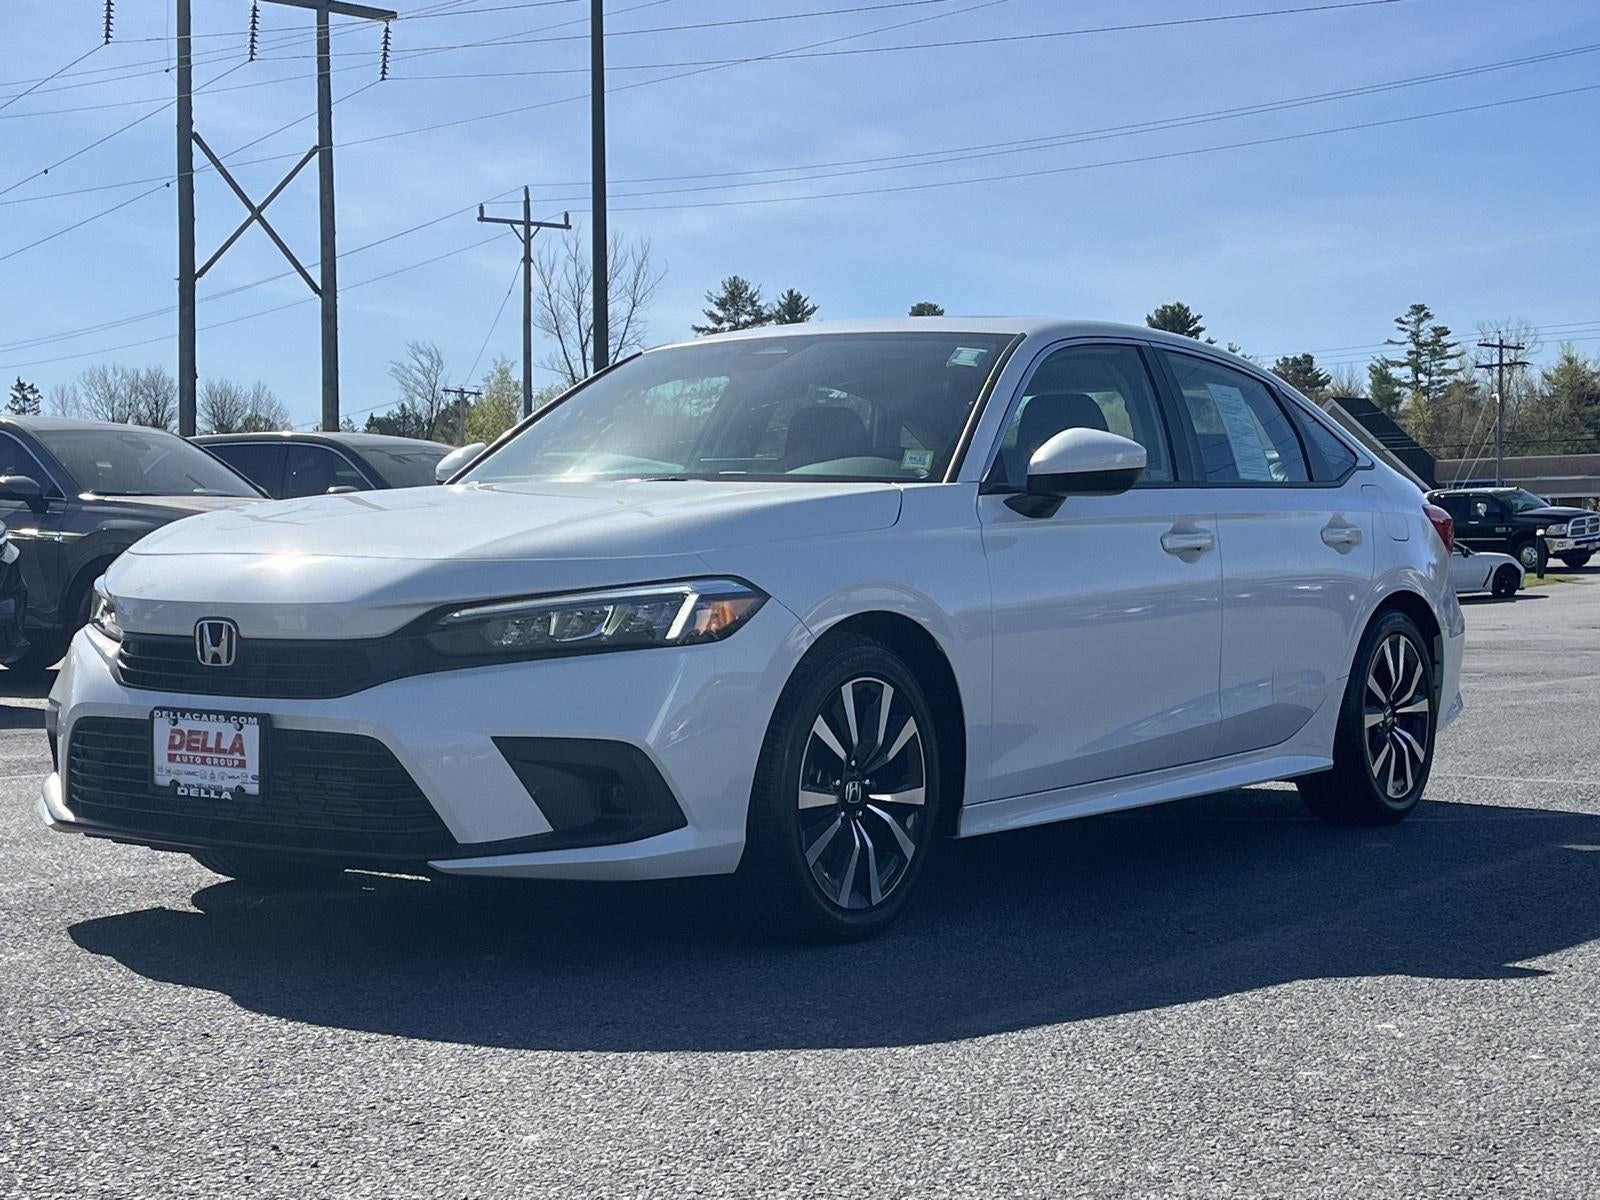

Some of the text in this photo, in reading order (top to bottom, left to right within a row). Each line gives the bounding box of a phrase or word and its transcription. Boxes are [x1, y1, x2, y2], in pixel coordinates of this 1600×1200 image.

[153, 710, 258, 725] DELLACARS.COM
[167, 728, 246, 757] DELLA
[175, 755, 240, 767] AUTO GROUP
[177, 787, 233, 800] DELLA
